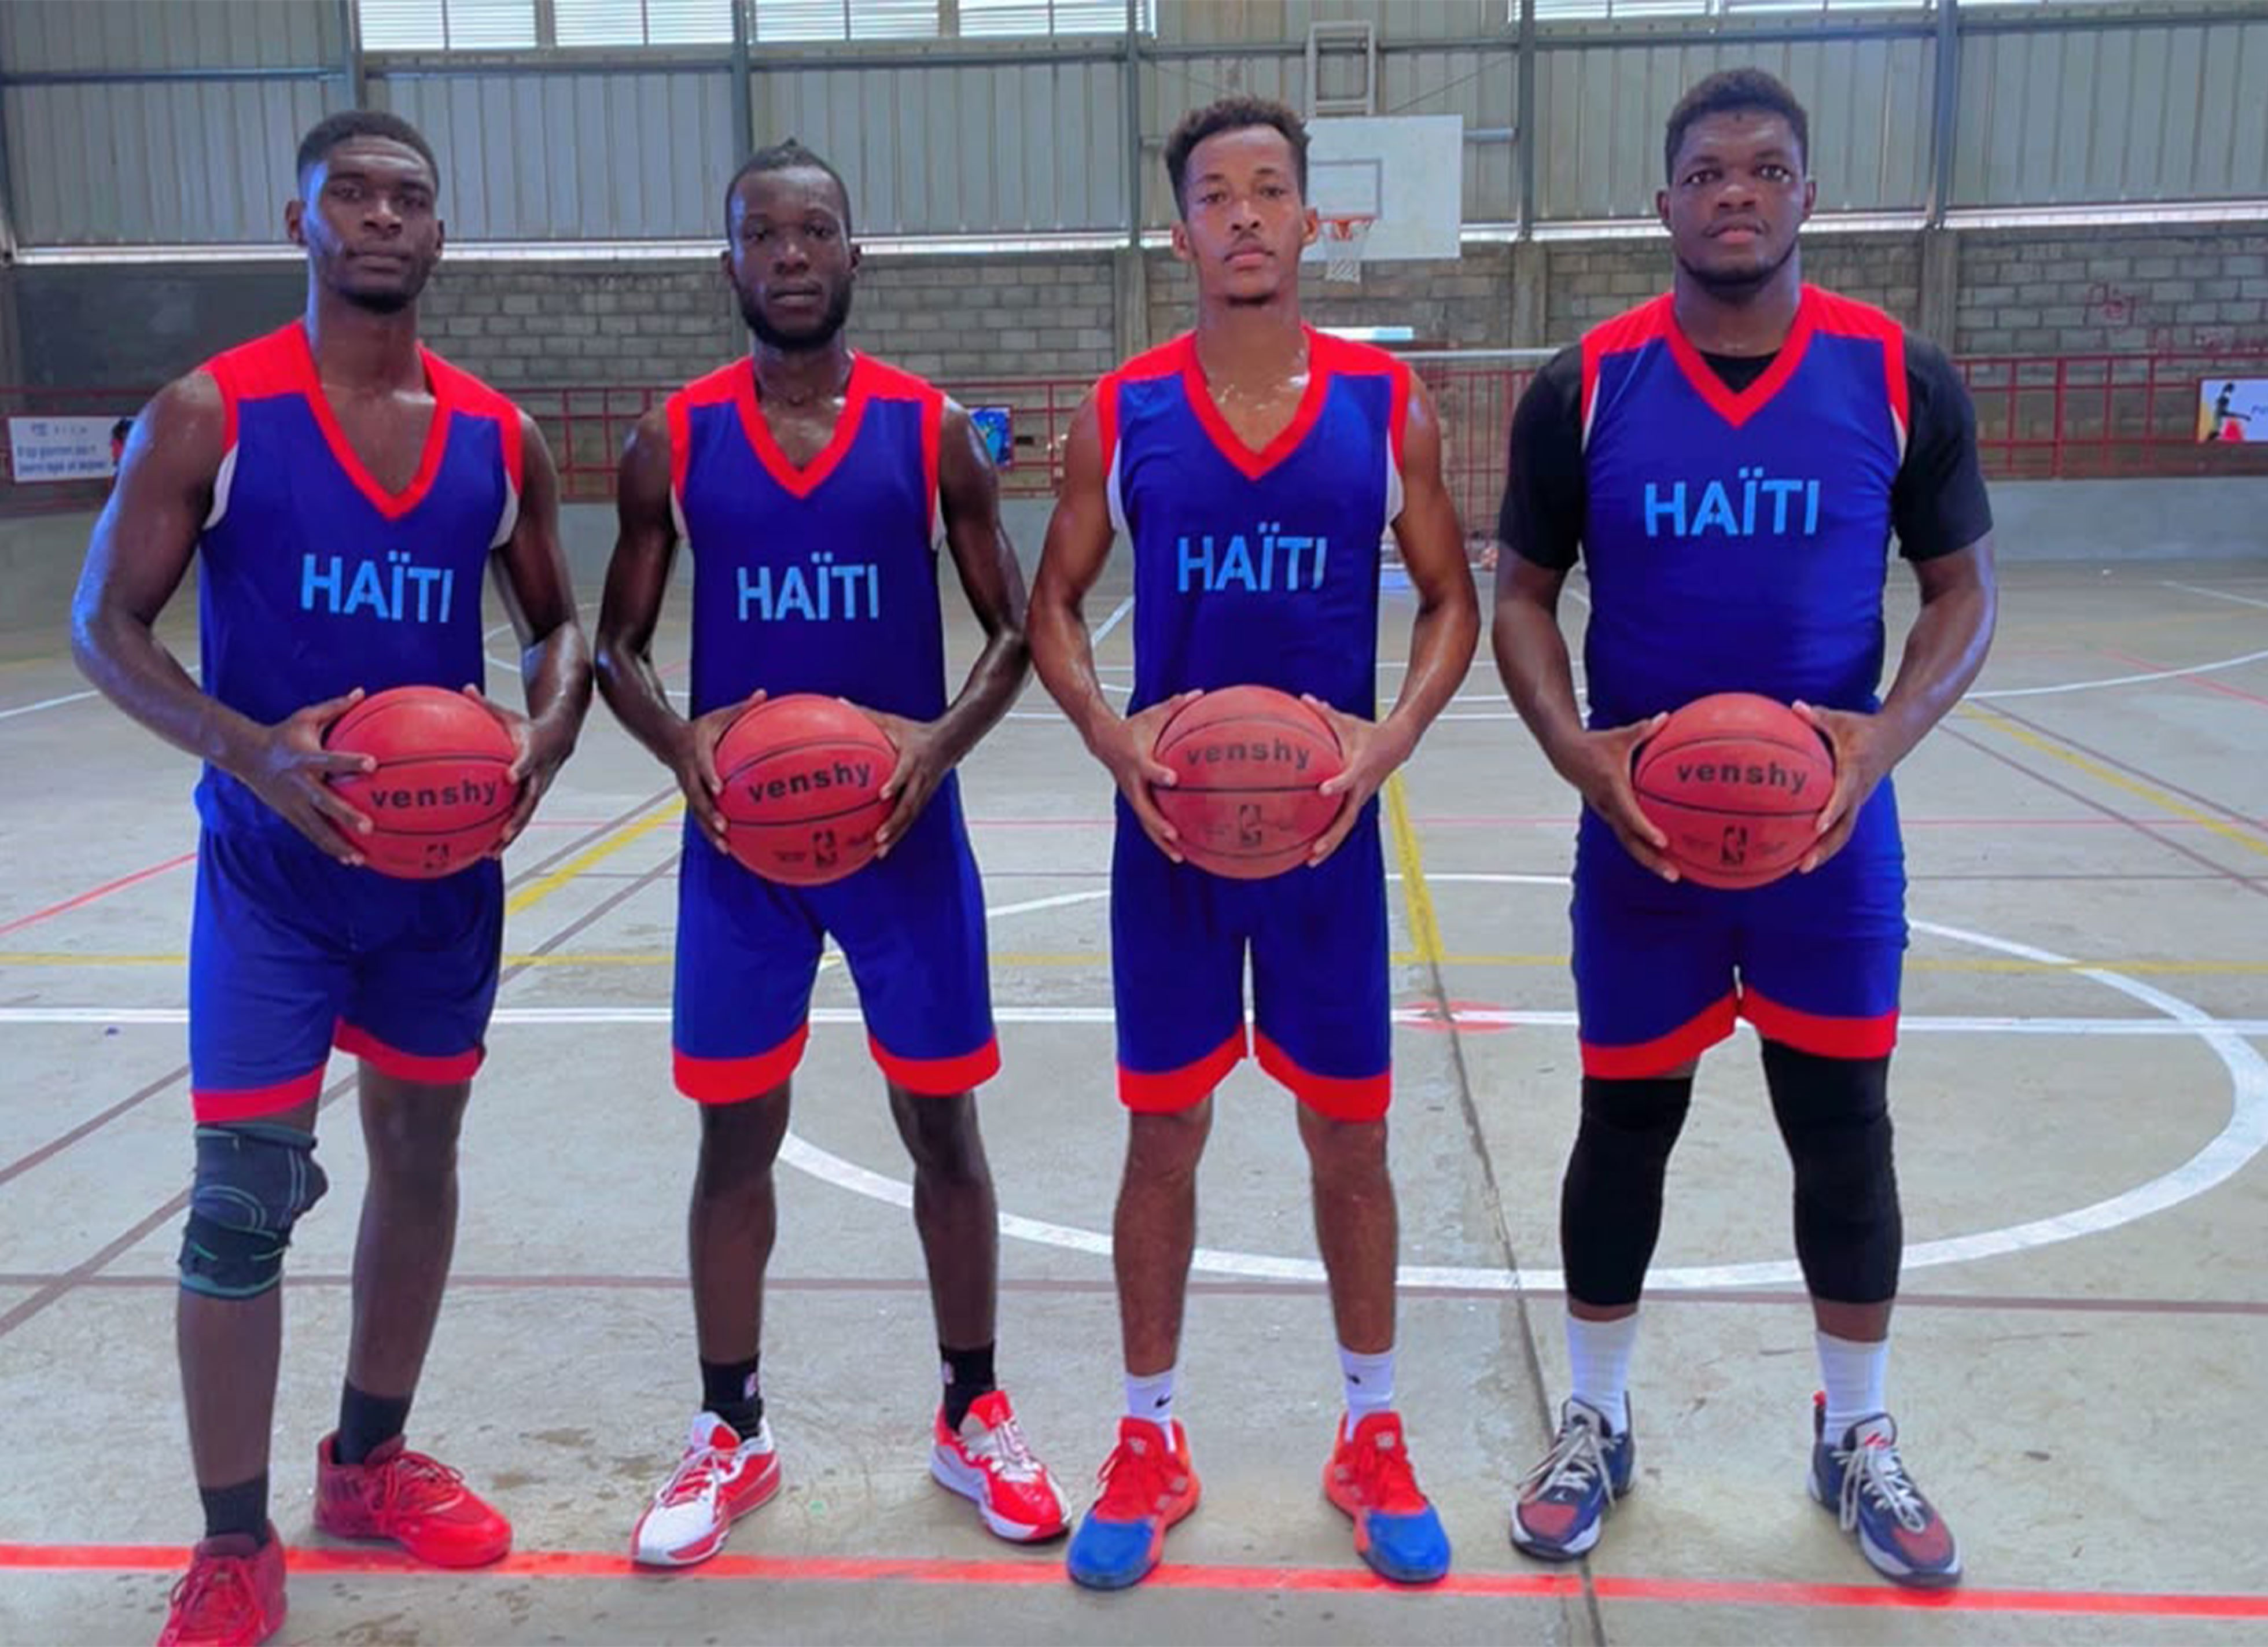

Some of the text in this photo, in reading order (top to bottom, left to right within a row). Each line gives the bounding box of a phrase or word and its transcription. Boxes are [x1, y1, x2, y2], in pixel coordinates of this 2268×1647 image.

[1645, 467, 1820, 536] HAÏTI
[1178, 522, 1327, 592] HAÏTI
[301, 550, 454, 623] HAÏTI
[737, 551, 879, 621] HAÏTI
[1187, 738, 1309, 770] venshy
[1677, 762, 1806, 795] venshy
[371, 780, 496, 808] venshy
[748, 762, 870, 803] venshy
